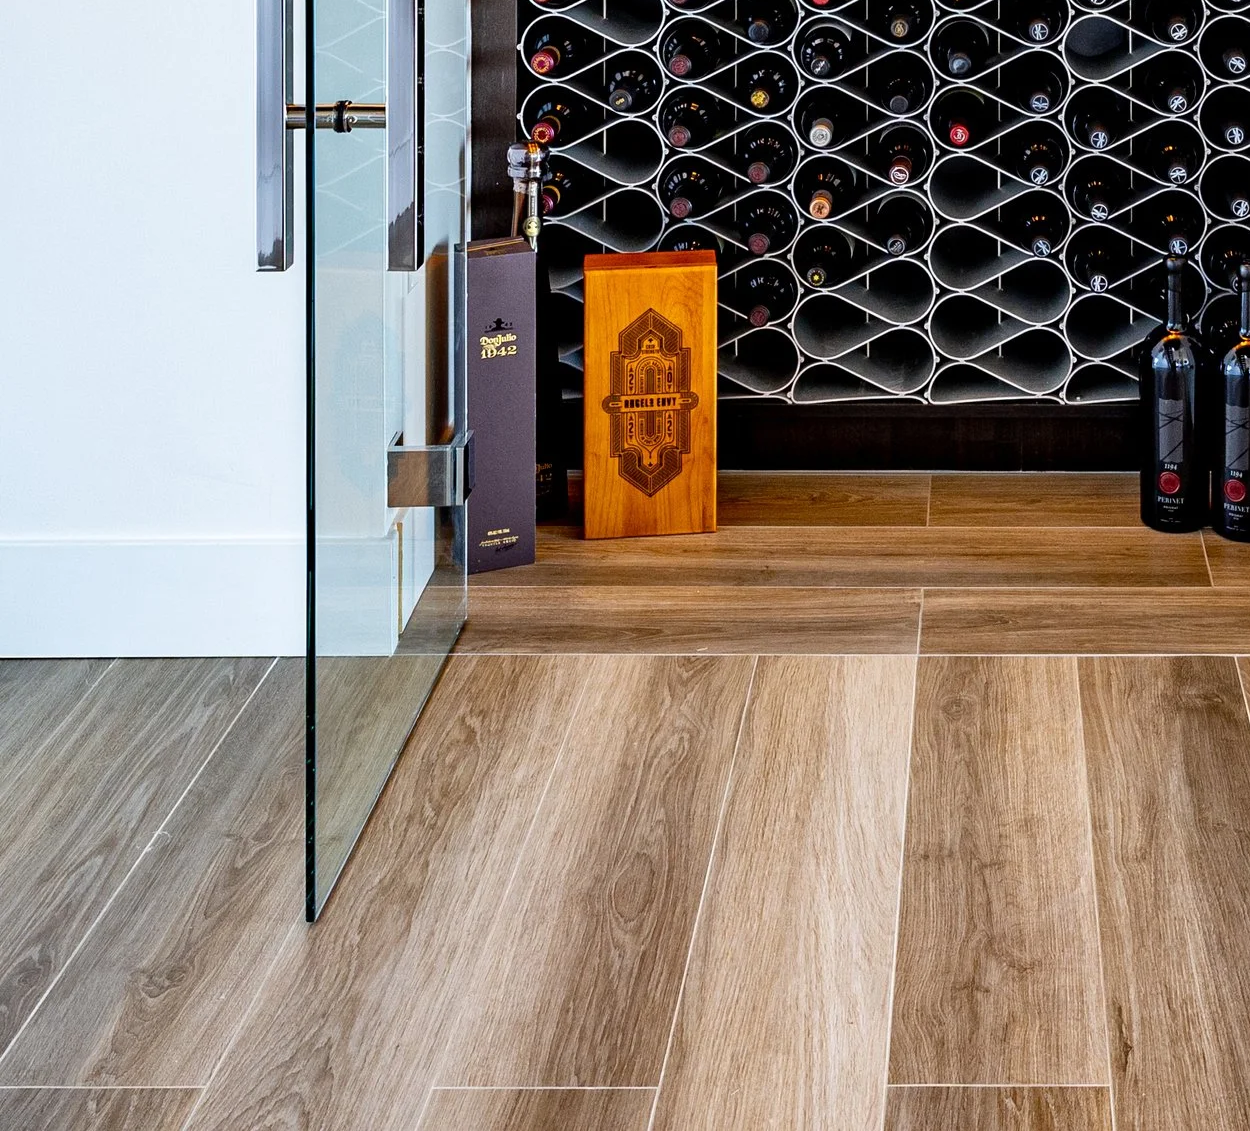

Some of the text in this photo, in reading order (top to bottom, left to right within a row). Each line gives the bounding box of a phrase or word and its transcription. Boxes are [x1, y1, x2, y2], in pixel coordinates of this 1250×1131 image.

[480, 345, 518, 360] 1942
[656, 396, 677, 407] ENVY
[1164, 463, 1178, 471] 1194
[1230, 470, 1243, 479] 1194
[1157, 495, 1185, 505] PERINET
[1223, 502, 1250, 513] PERINET
